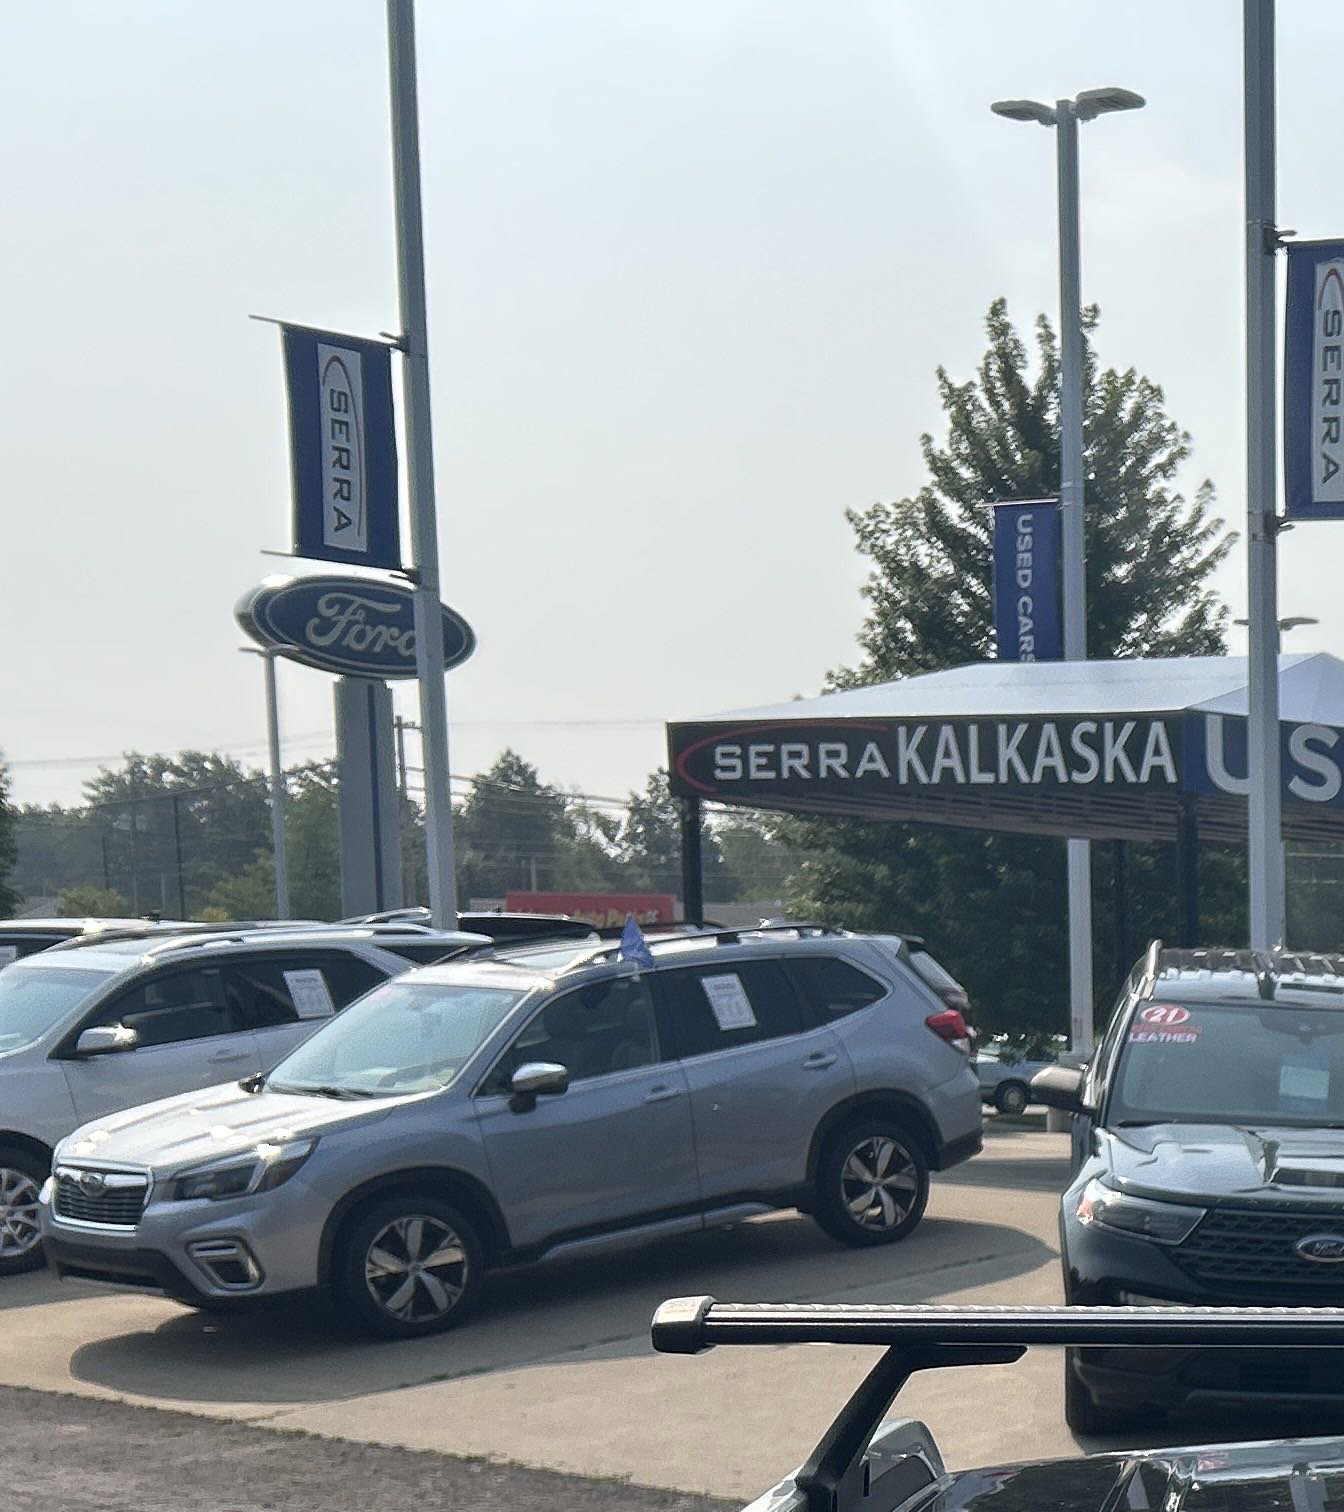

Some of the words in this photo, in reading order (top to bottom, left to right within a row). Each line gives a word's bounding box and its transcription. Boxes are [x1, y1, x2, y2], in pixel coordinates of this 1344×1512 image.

[1320, 308, 1342, 485] SERRA
[328, 388, 353, 534] SERRA
[1015, 513, 1033, 589] USED
[713, 742, 891, 781] SERRA
[898, 720, 1178, 785] KALKASKA
[1148, 1007, 1181, 1022] 21
